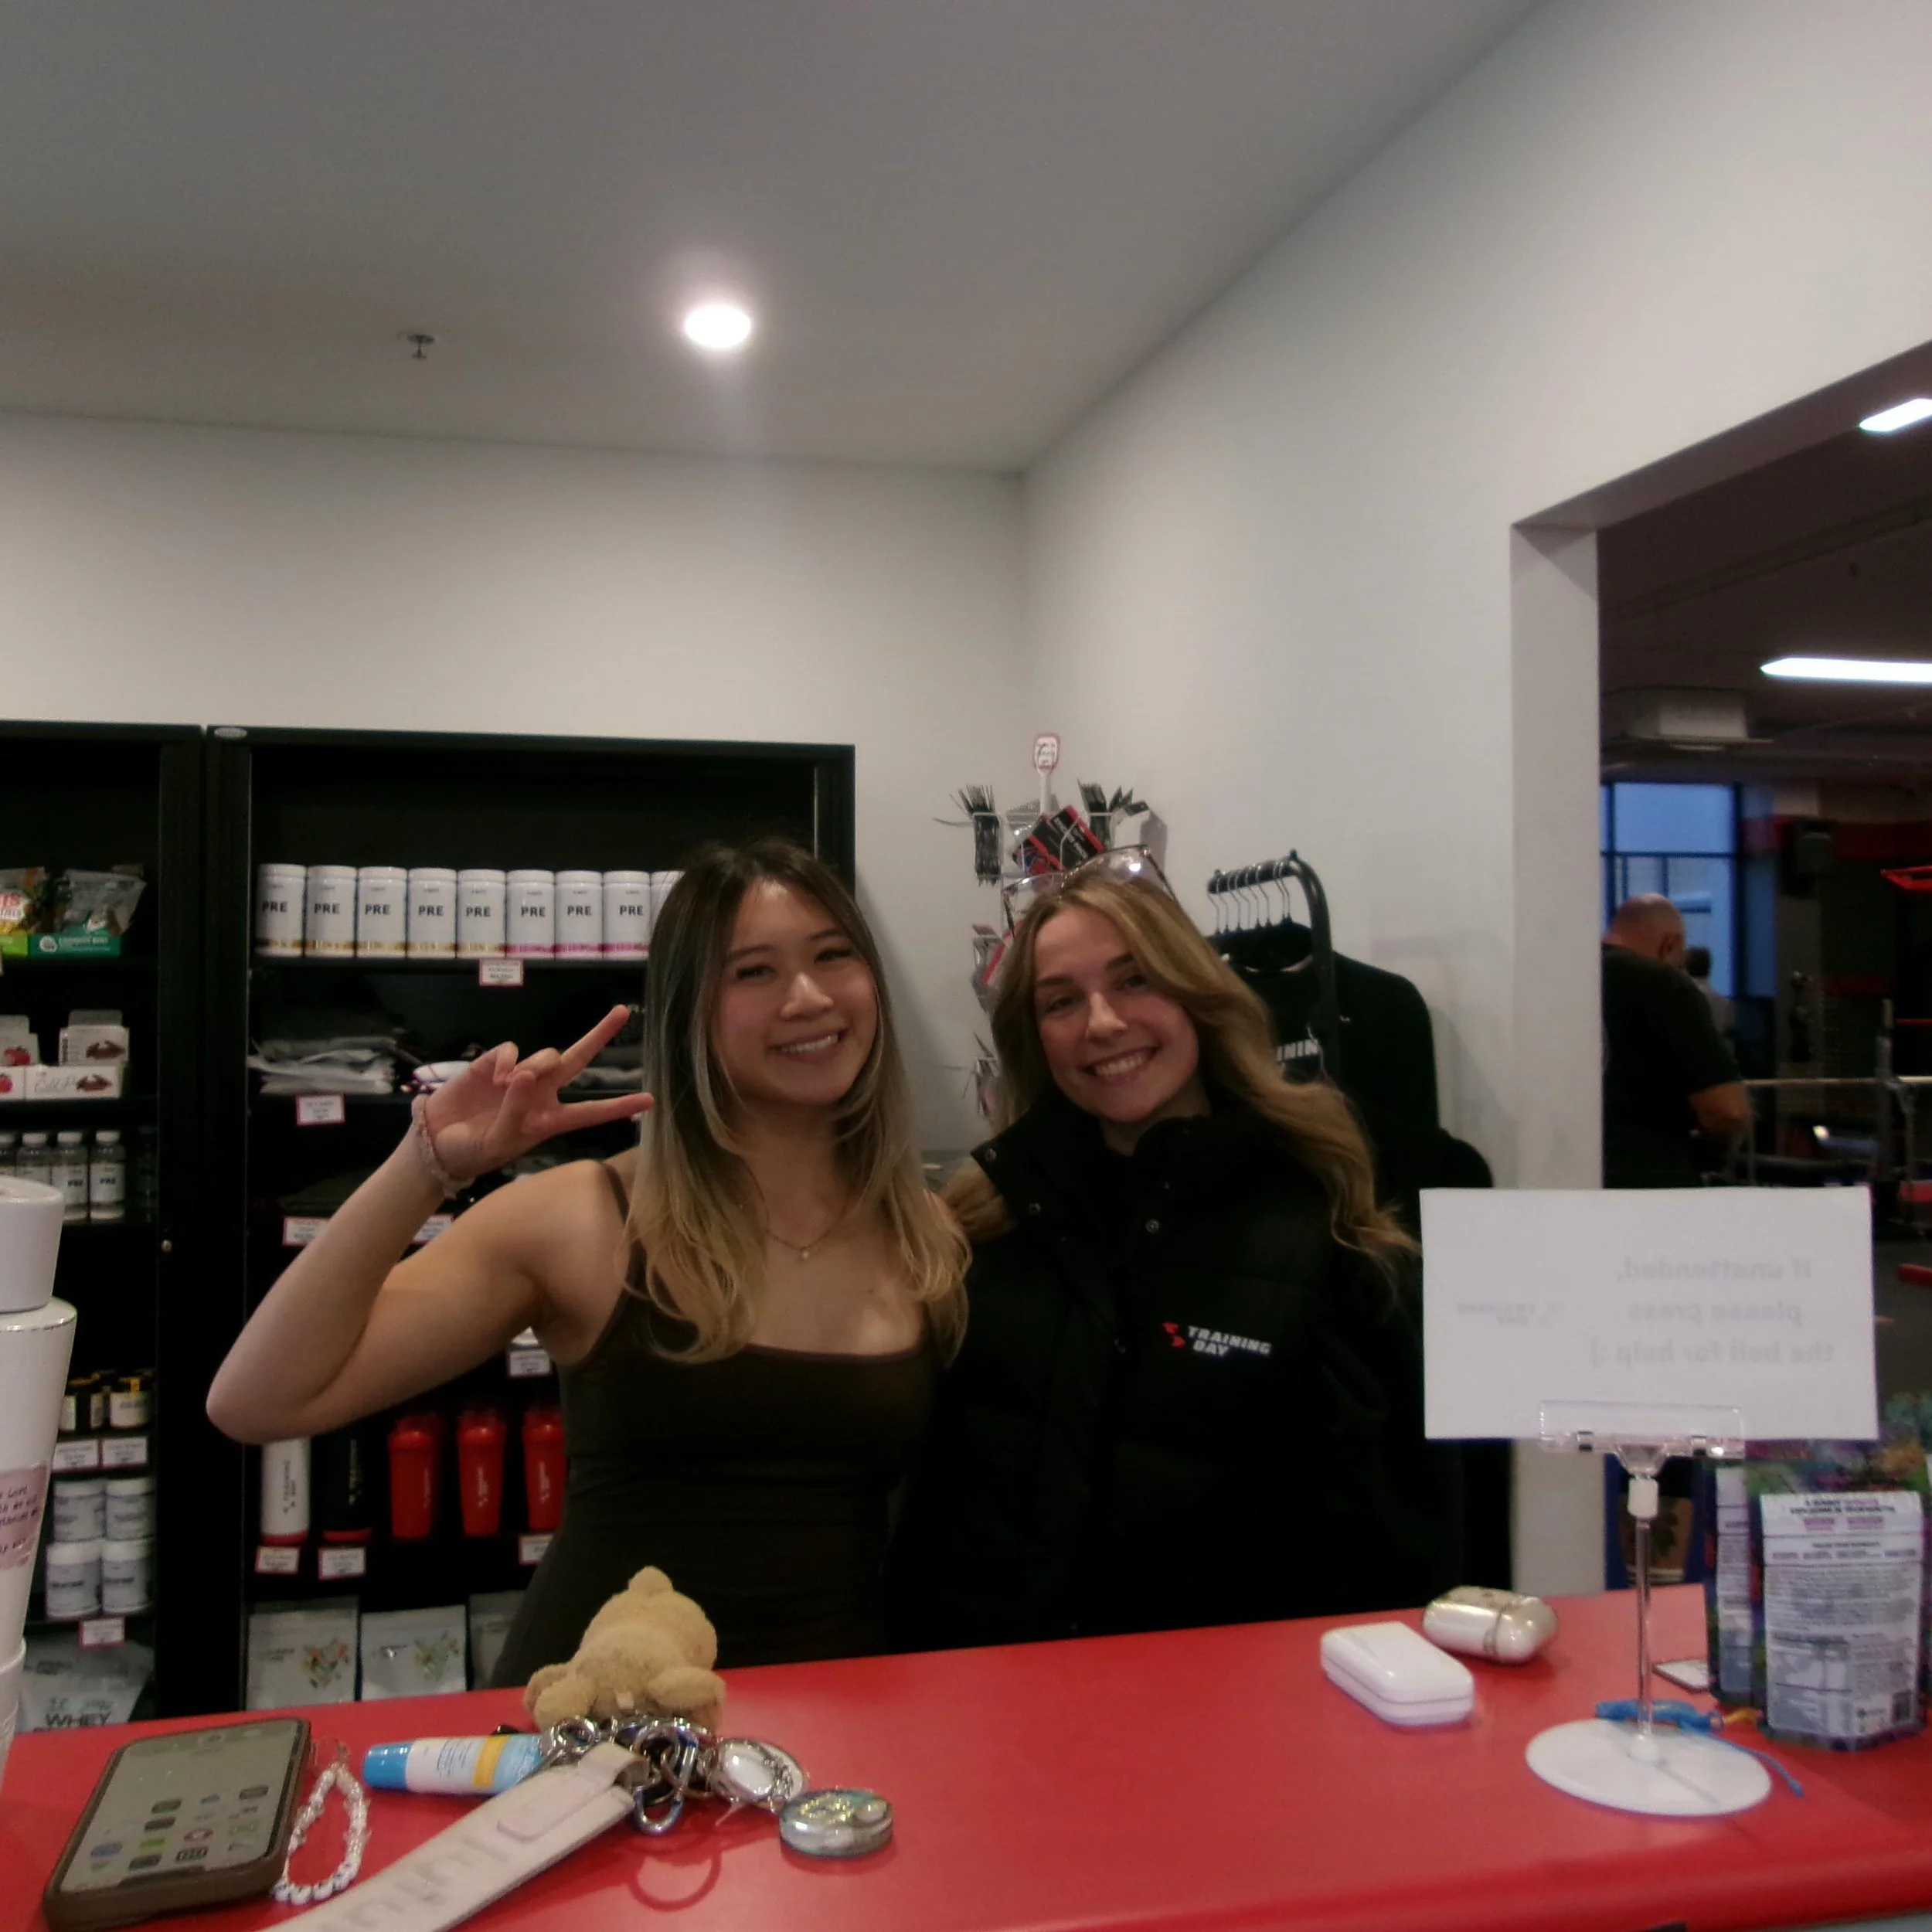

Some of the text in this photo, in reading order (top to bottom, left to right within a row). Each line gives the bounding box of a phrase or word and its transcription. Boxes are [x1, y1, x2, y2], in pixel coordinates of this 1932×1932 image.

[262, 901, 287, 913] PRE
[314, 903, 340, 914] PRE
[365, 904, 391, 915] PRE
[418, 905, 444, 917] PRE
[466, 906, 491, 917] PRE
[521, 906, 546, 917] PRE
[567, 905, 592, 917] PRE
[620, 905, 643, 917] PRE
[1189, 1325, 1272, 1355] TRAINING
[1193, 1339, 1230, 1356] DAY
[45, 1712, 111, 1728] WHEY
